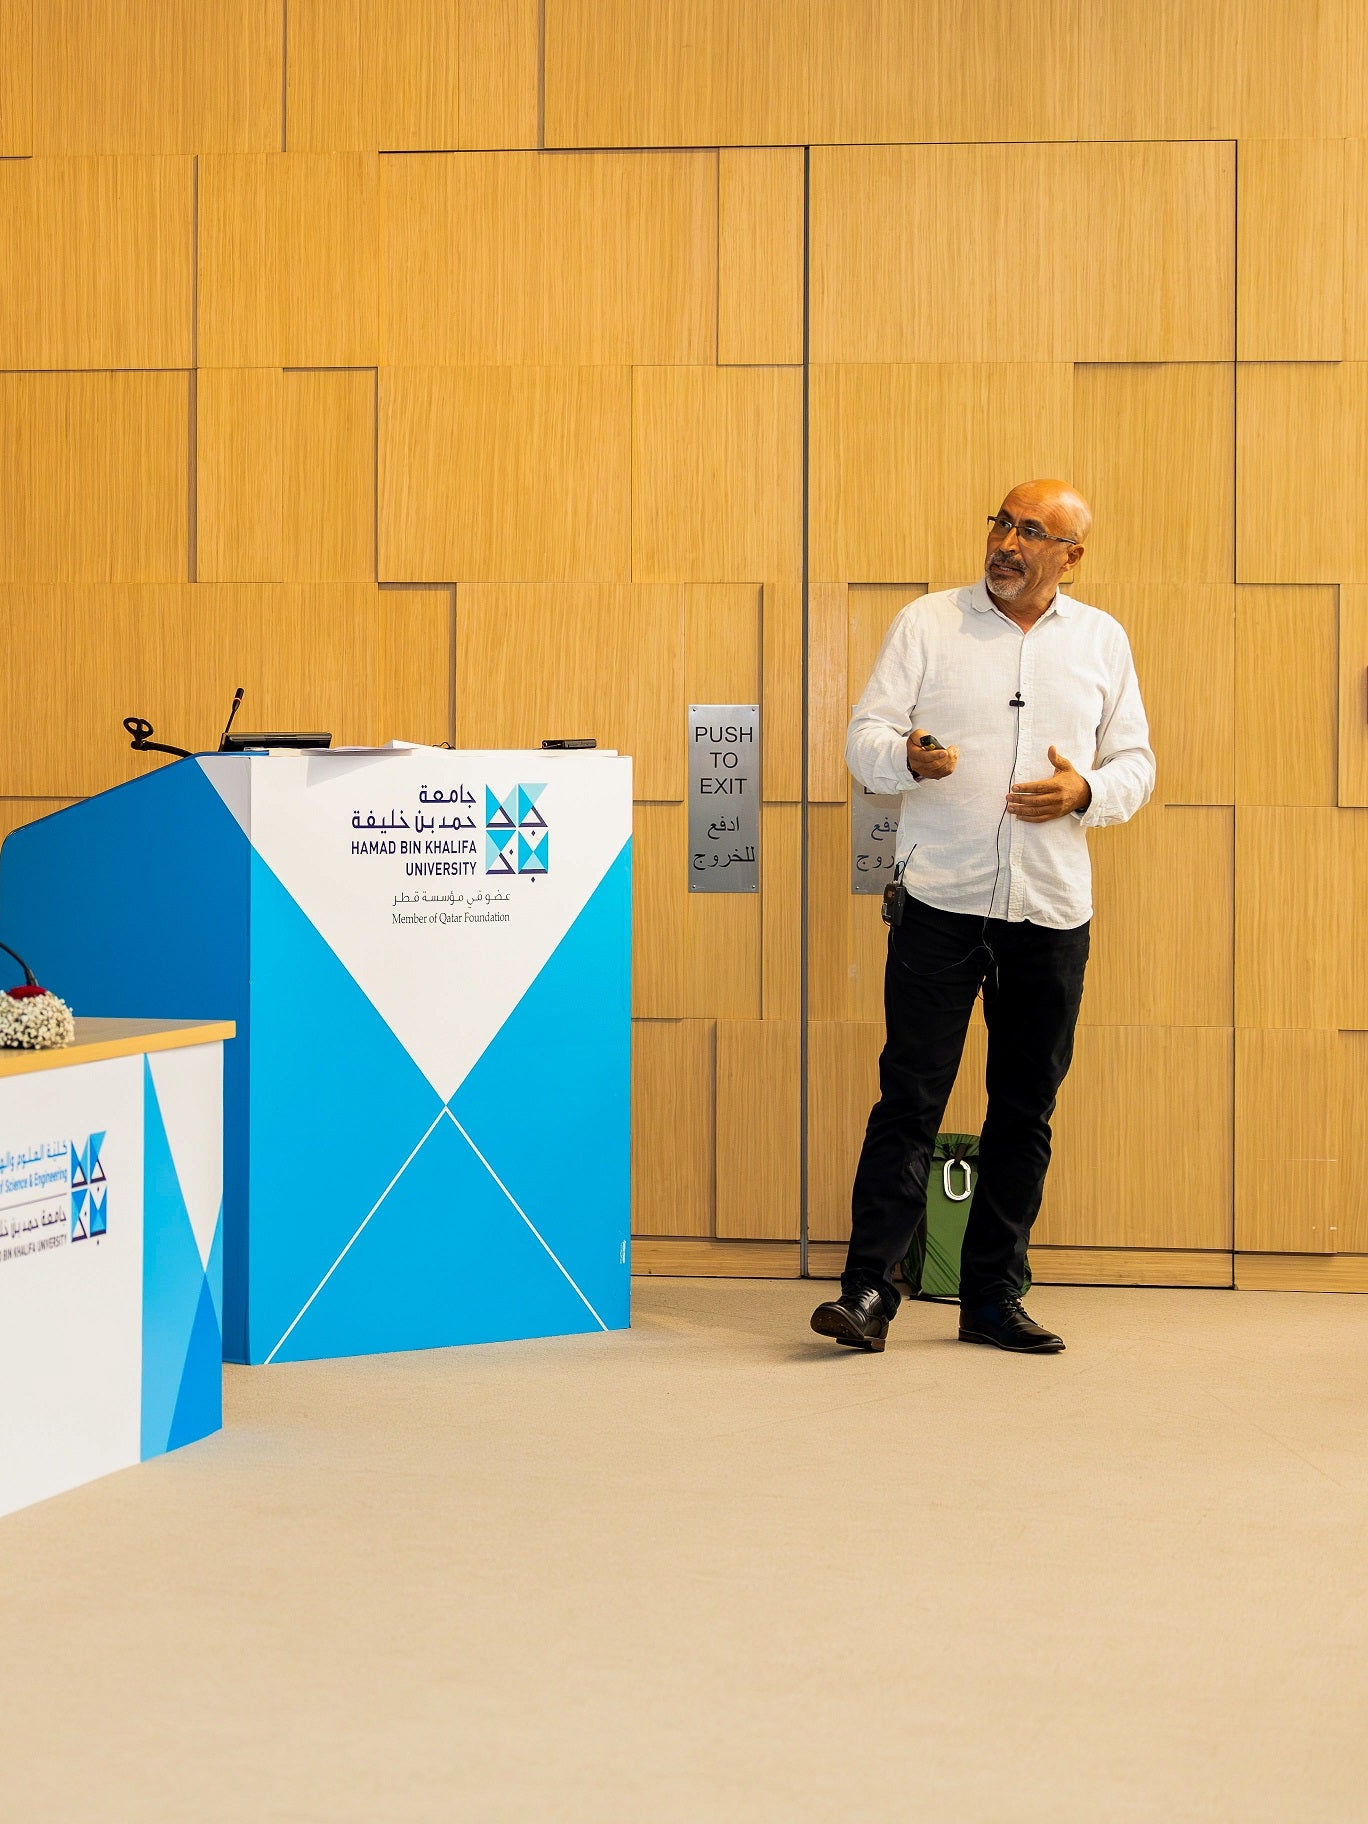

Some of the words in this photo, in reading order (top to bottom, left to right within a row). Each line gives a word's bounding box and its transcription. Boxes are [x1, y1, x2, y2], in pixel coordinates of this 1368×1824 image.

[695, 726, 753, 743] PUSH
[709, 752, 738, 769] TO
[700, 778, 747, 795] EXIT
[419, 783, 476, 809] جامعة
[352, 809, 410, 834] خليفة
[415, 809, 435, 834] بن
[439, 815, 476, 831] حمد
[707, 815, 740, 840] ادفع
[351, 840, 396, 855] HAMAD
[400, 840, 422, 854] BIN
[425, 840, 476, 854] KHALIFA
[693, 846, 755, 871] للخروج
[405, 862, 476, 876] UNIVERSITY
[392, 890, 420, 907] قطر
[422, 890, 464, 906] مؤسسة
[466, 890, 482, 909] في
[485, 889, 510, 906] عضو
[392, 913, 427, 925] Member
[428, 912, 438, 924] of
[439, 912, 463, 925] Qatar
[464, 912, 510, 924] Foundation
[5, 1176, 28, 1194] Science
[29, 1173, 34, 1189] &
[34, 1168, 68, 1190] Engineering
[3, 1246, 12, 1261] BIN
[13, 1241, 36, 1259] KHALIFA
[37, 1234, 67, 1252] UNIVERSITY
